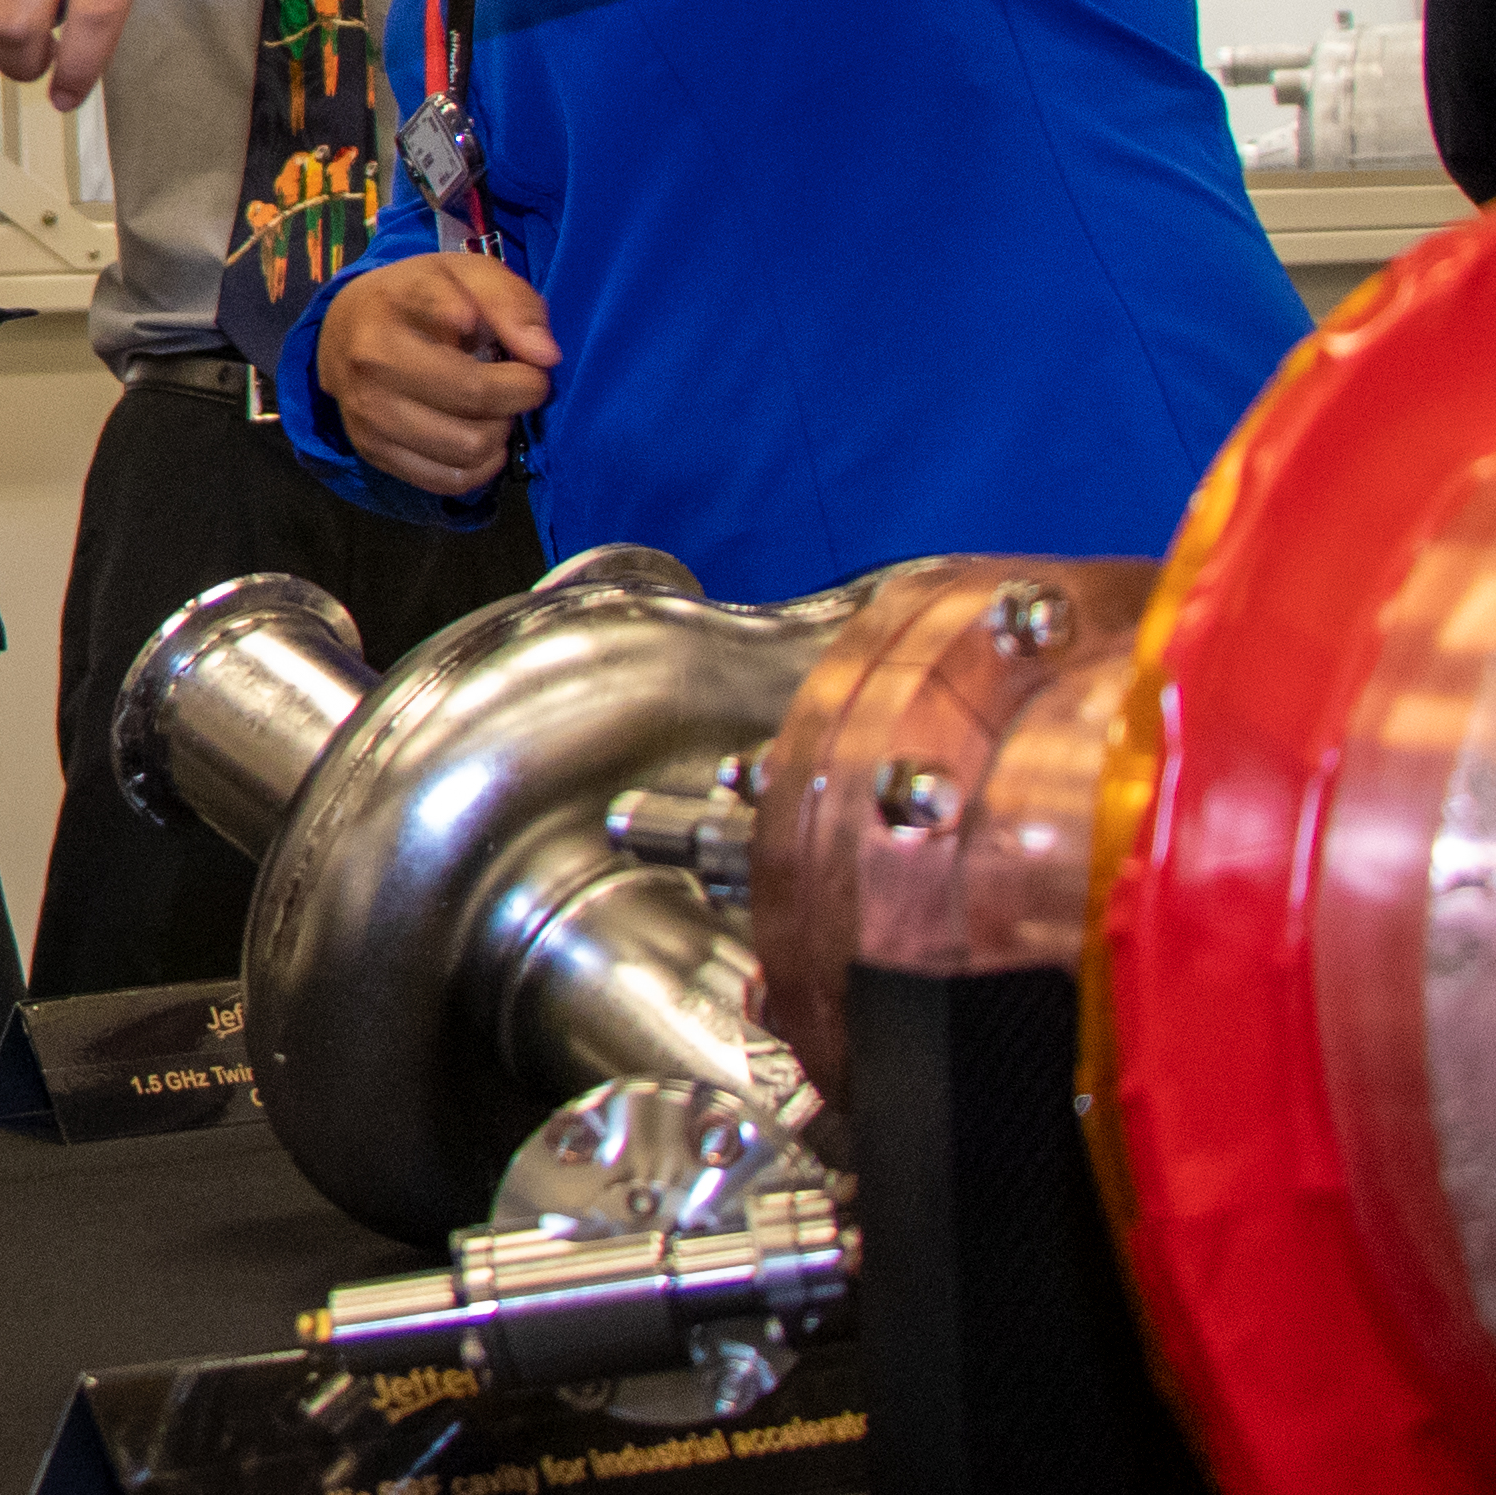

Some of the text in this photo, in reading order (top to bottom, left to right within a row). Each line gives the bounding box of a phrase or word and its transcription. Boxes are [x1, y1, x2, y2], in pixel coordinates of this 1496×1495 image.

[130, 1074, 162, 1096] 1.5
[164, 1070, 210, 1092] GHz
[540, 1454, 587, 1486] for
[587, 1427, 731, 1480] industrial
